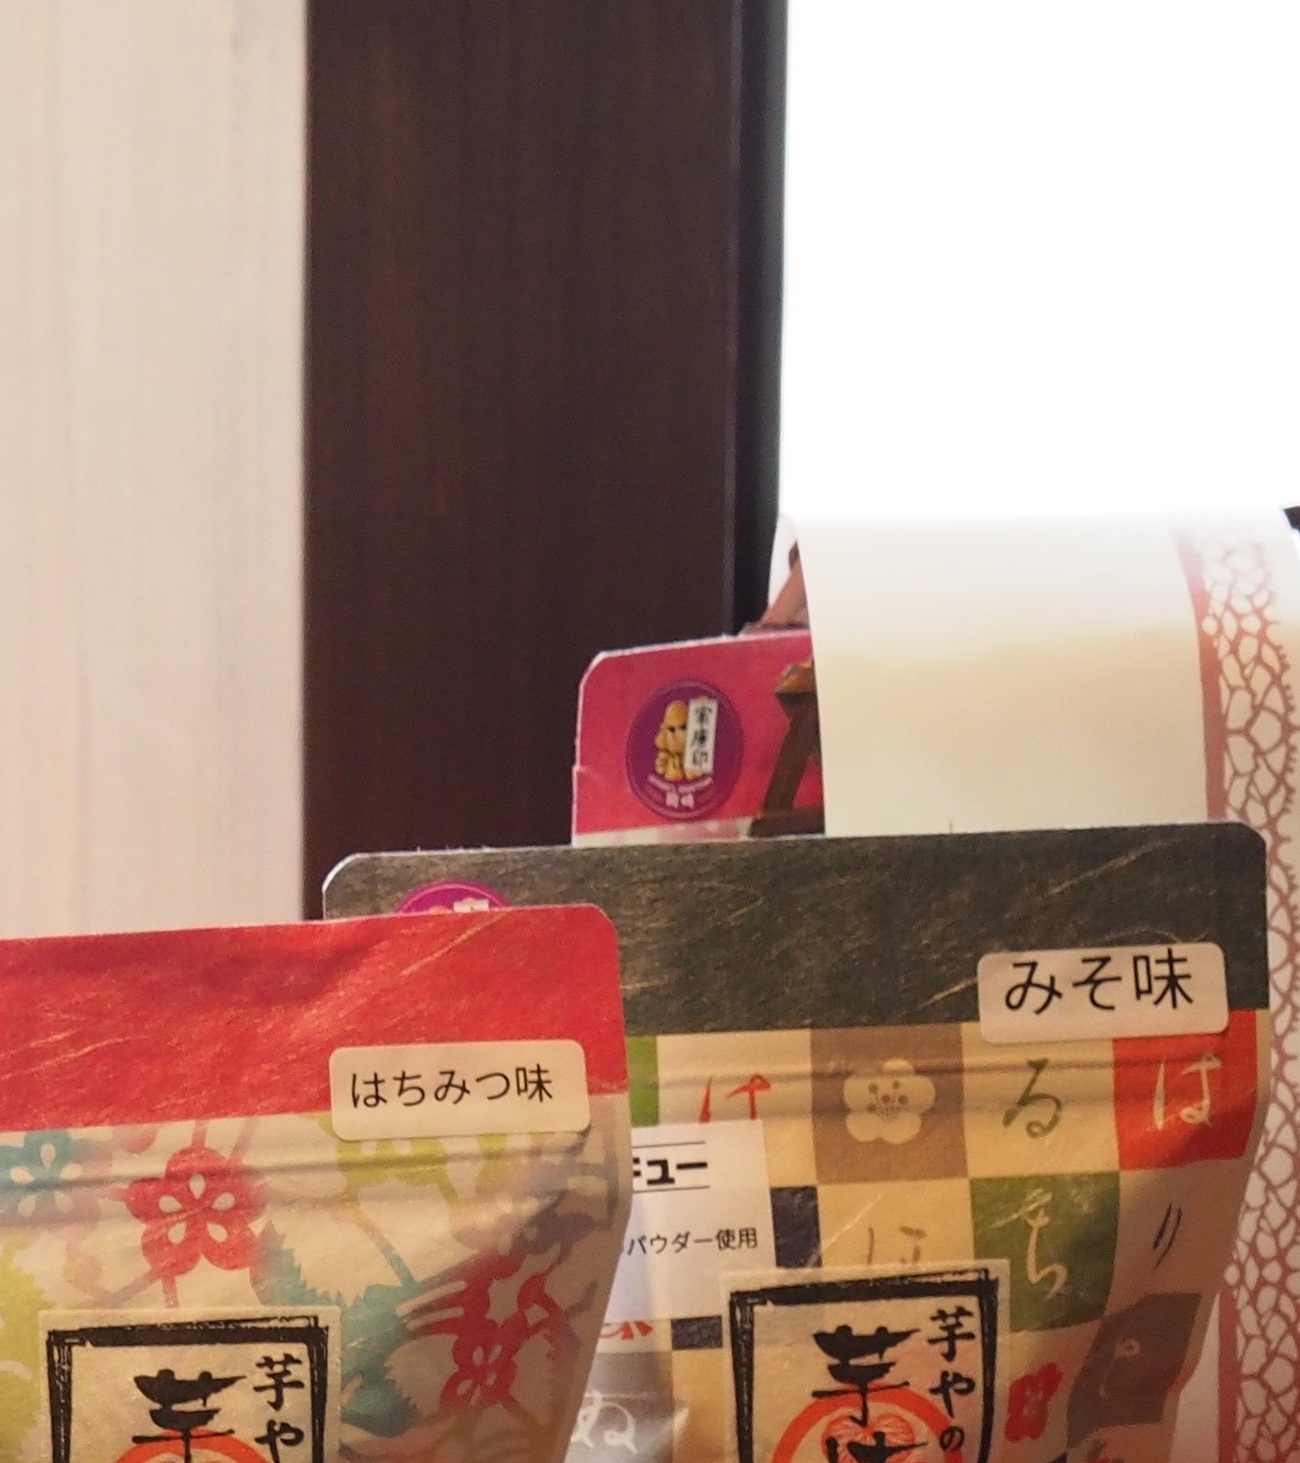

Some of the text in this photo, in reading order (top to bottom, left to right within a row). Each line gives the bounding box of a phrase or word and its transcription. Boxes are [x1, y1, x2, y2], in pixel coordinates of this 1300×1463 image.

[1004, 947, 1194, 1015] みそ味
[351, 1063, 553, 1109] はちみつ味
[626, 1226, 758, 1256] パウダー使用
[926, 1306, 976, 1452] 芋やの
